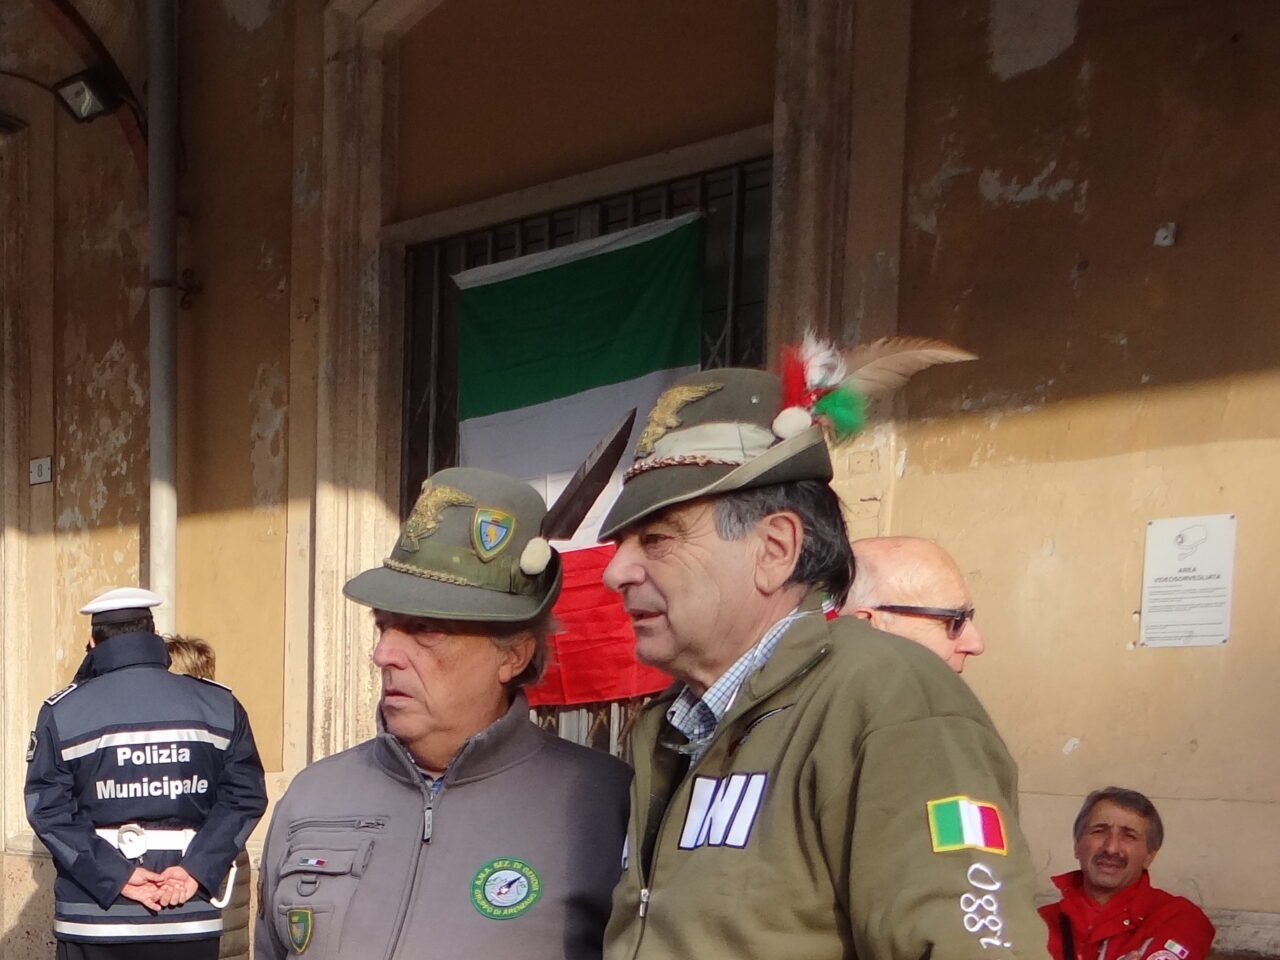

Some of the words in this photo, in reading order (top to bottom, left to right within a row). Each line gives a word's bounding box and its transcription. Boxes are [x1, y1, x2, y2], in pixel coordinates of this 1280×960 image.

[117, 744, 190, 766] Polizia
[95, 774, 209, 800] Municipale
[960, 862, 1013, 949] Oggi
